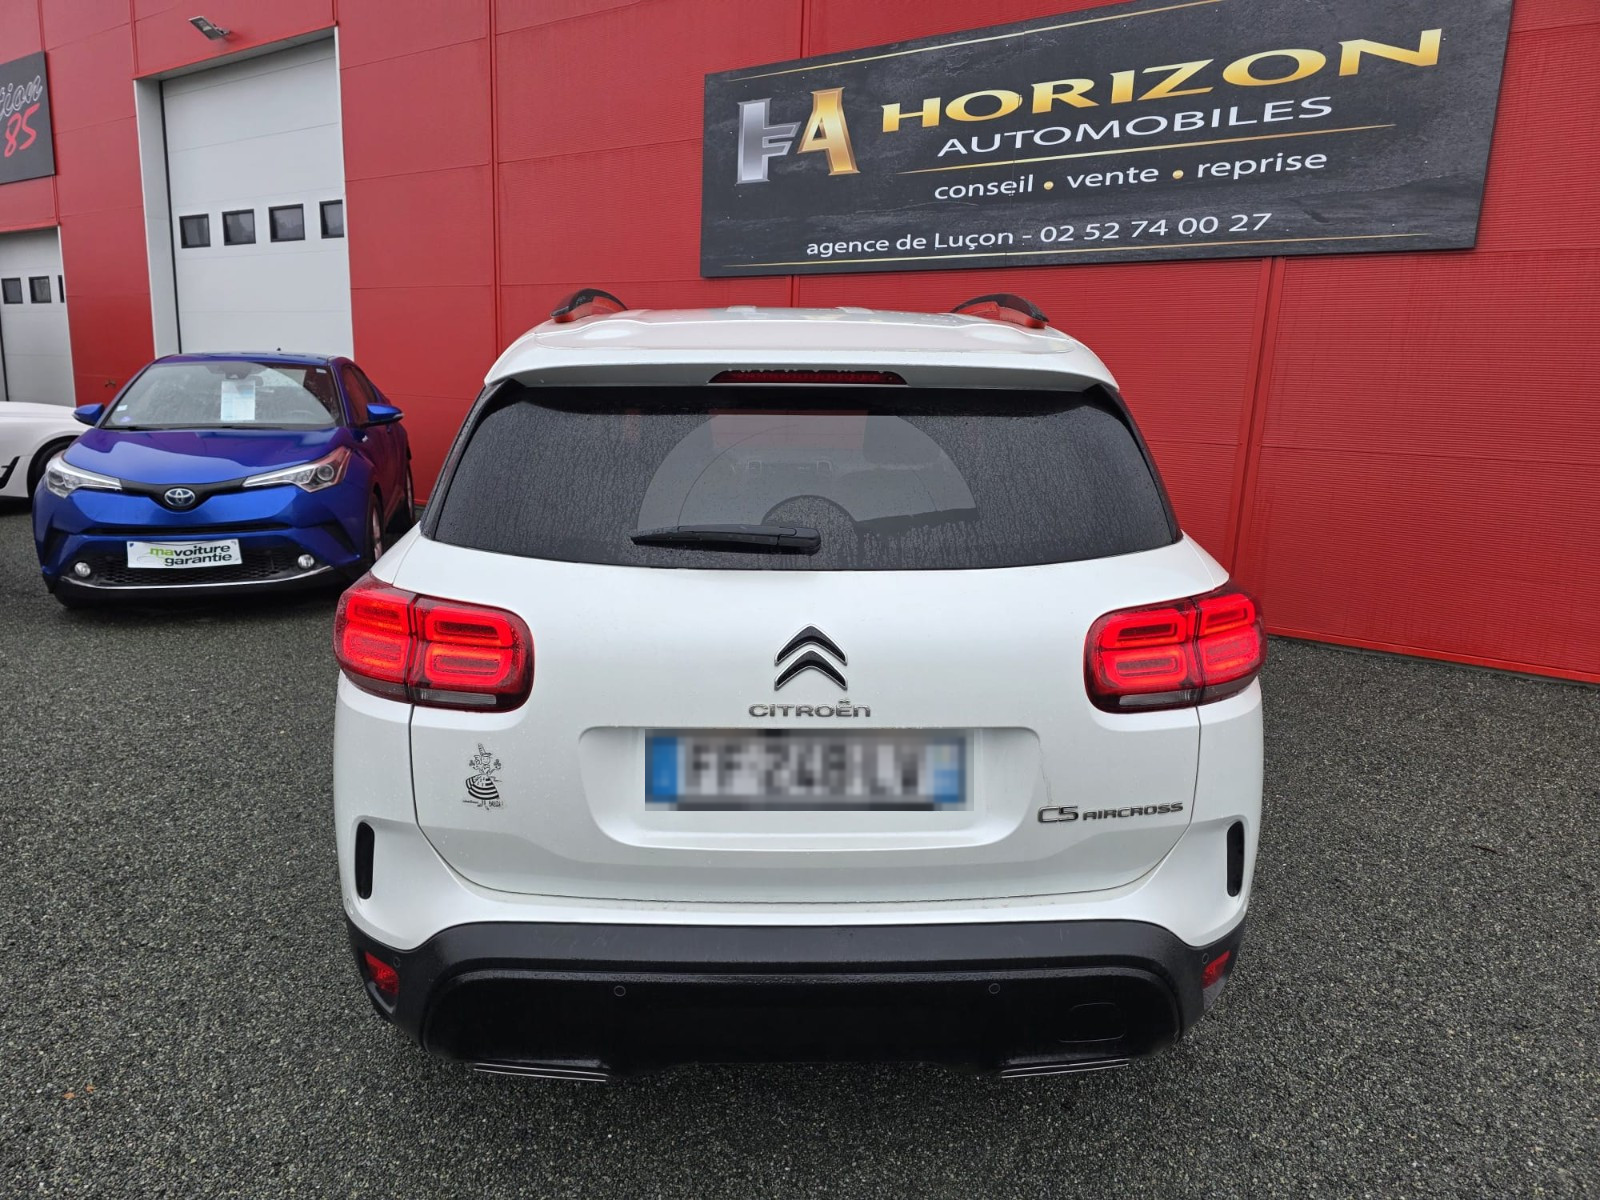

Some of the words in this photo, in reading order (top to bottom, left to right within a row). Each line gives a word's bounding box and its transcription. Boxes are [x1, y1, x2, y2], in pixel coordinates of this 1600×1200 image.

[881, 28, 1442, 133] HORIZON
[4, 102, 41, 158] 85
[937, 96, 1333, 157] AUTOMOBILES
[934, 174, 1034, 200] conseil
[1067, 167, 1159, 189] vente
[1197, 152, 1328, 180] reprise
[806, 237, 890, 257] agence
[896, 233, 927, 250] de
[935, 230, 1014, 251] Luçon
[1040, 225, 1075, 243] 02
[1083, 222, 1120, 241] 52
[1130, 219, 1169, 238] 74
[1178, 216, 1219, 235] 00
[1228, 213, 1272, 232] 27
[164, 553, 232, 566] garantie
[1037, 805, 1079, 824] C5
[1082, 802, 1184, 821] AIRCROSS
